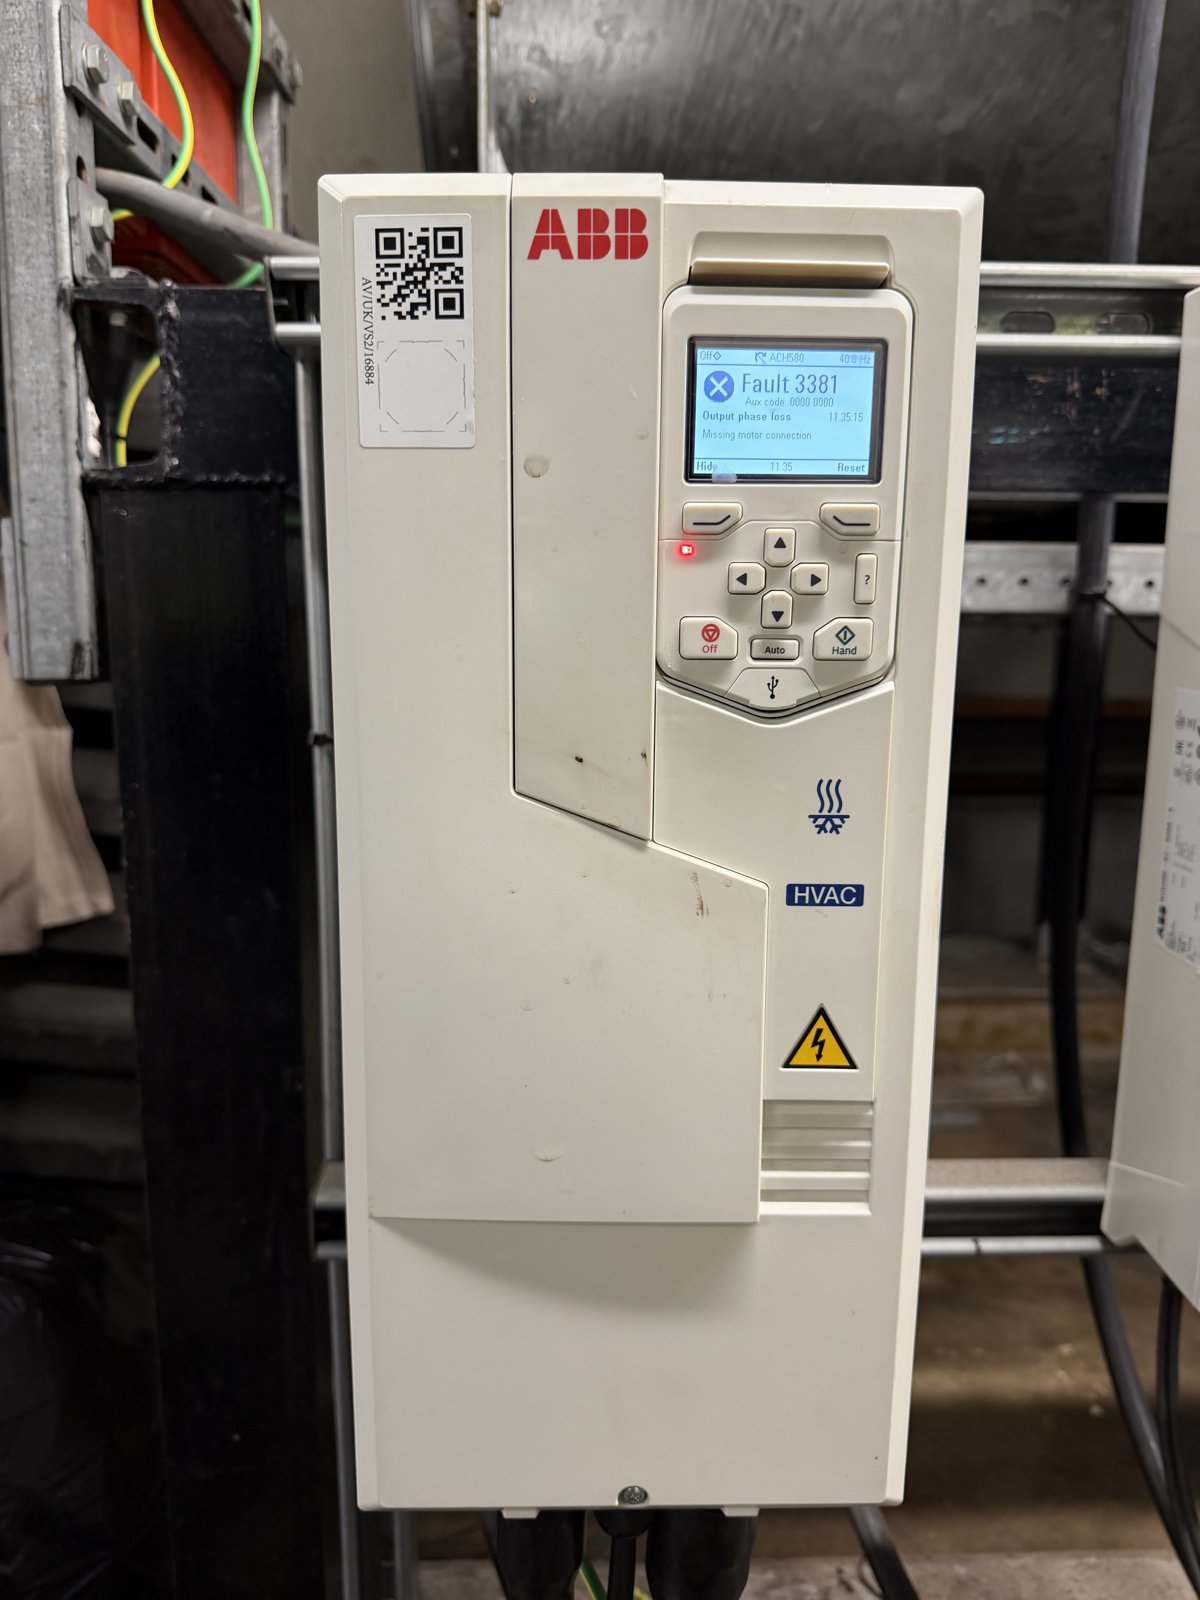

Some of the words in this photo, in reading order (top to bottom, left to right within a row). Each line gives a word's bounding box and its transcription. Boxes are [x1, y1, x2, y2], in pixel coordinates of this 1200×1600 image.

[527, 208, 648, 260] ABB
[362, 276, 375, 386] AV/UK/VS2/16884
[700, 351, 713, 361] Off
[769, 353, 804, 363] ACH580
[859, 355, 871, 365] Hz
[742, 373, 790, 394] Fault
[795, 374, 838, 394] 3381
[745, 397, 762, 407] Aux
[789, 397, 811, 407] 0000
[813, 397, 834, 408] 0000
[702, 411, 734, 422] Output
[738, 411, 767, 422] phase
[770, 411, 791, 421] loss
[828, 412, 864, 422] 113515
[702, 430, 736, 441] Missing
[738, 431, 763, 440] motor
[765, 431, 812, 440] connection
[770, 462, 793, 472] 1135
[837, 463, 866, 473] Reset
[864, 574, 871, 585] ?
[702, 644, 718, 654] Off
[764, 646, 786, 655] Auto
[831, 645, 857, 655] Hand
[794, 886, 857, 904] HVAC
